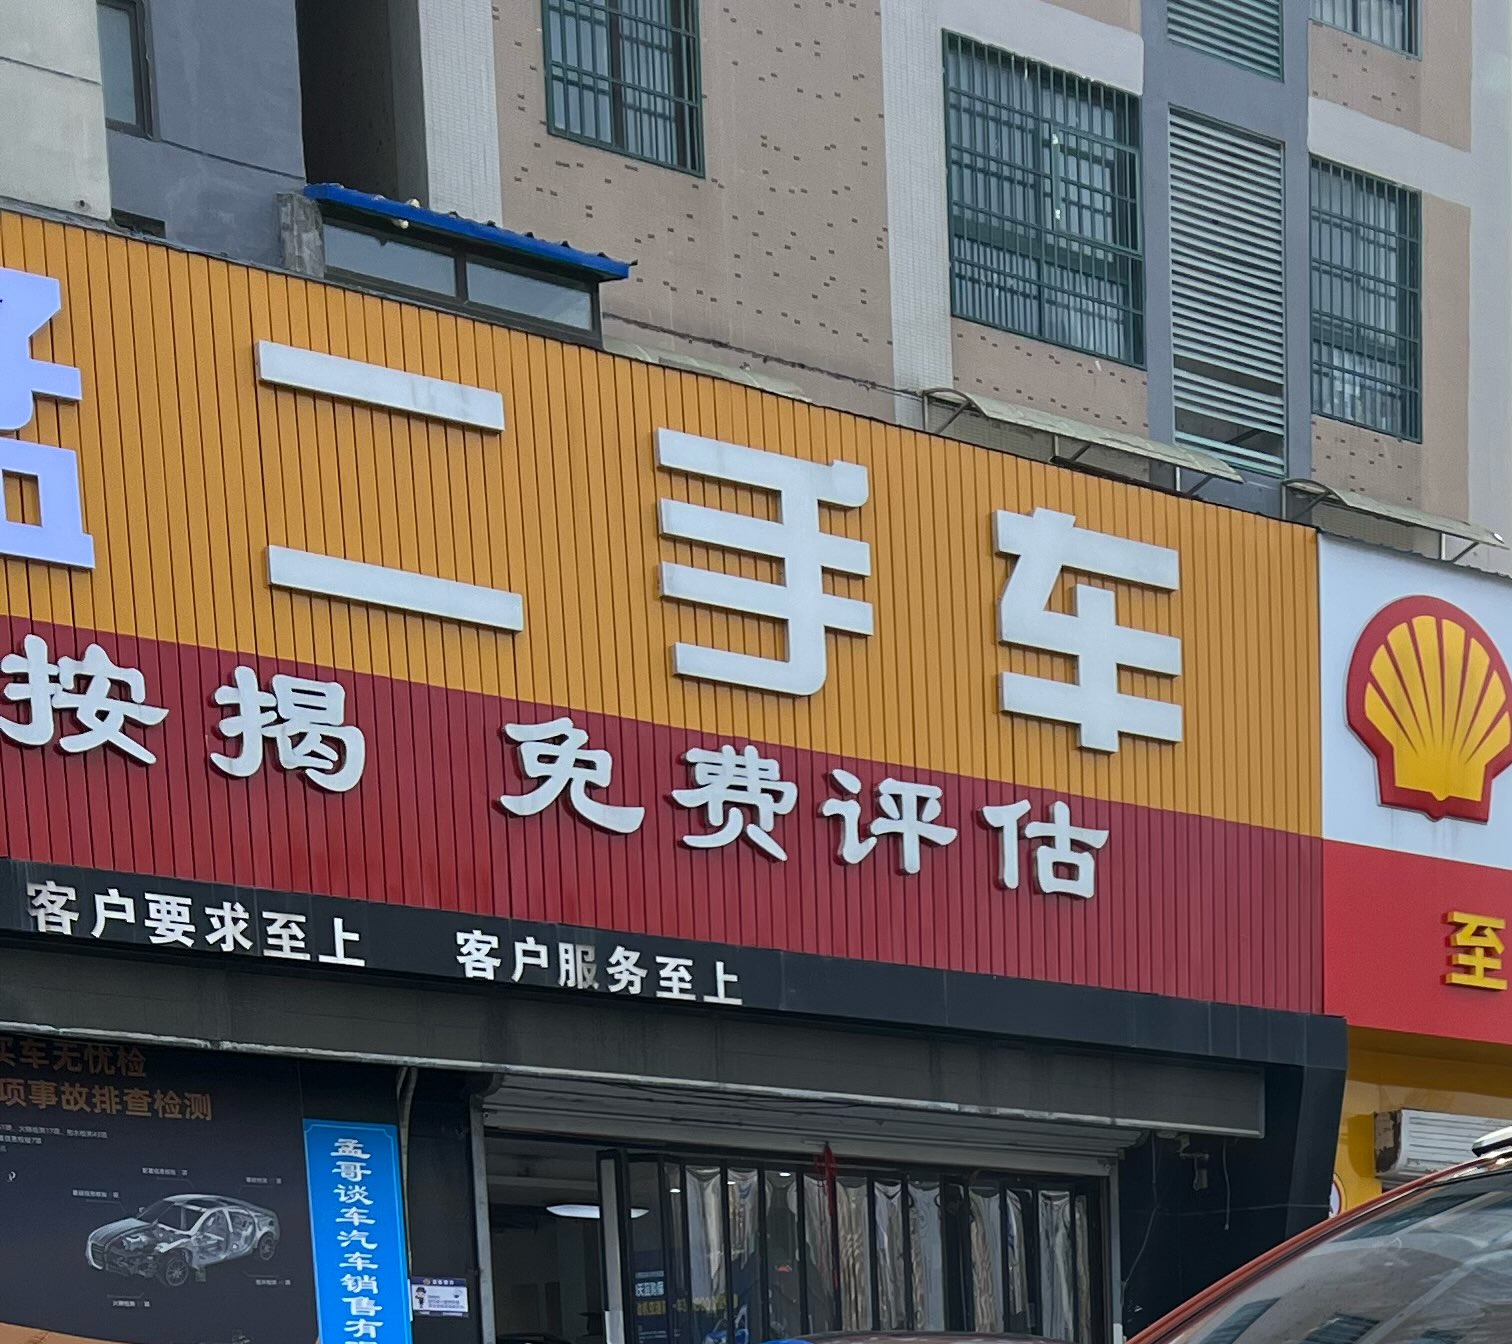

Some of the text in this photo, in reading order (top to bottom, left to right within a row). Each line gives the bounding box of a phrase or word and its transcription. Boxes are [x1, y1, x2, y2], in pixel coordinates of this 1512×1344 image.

[256, 339, 1183, 754] 二手车
[0, 634, 1110, 900] 按揭 免费评估
[26, 880, 744, 1006] 客户要求至上 客户服务至上
